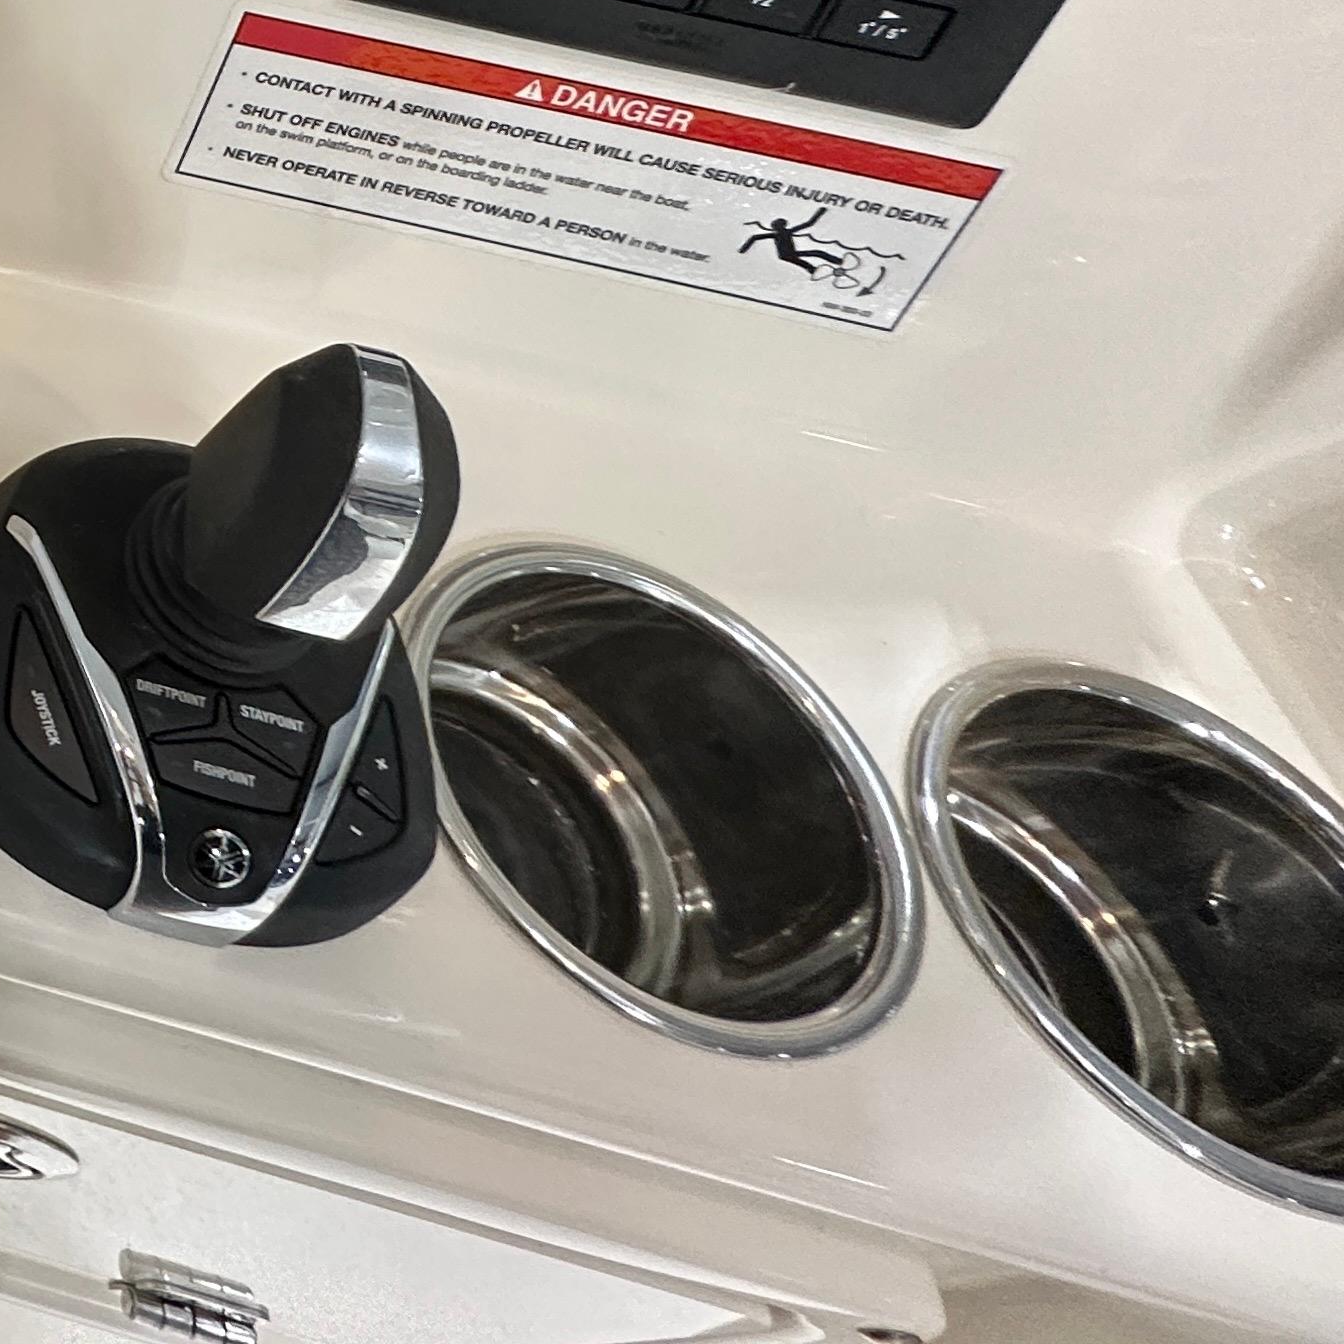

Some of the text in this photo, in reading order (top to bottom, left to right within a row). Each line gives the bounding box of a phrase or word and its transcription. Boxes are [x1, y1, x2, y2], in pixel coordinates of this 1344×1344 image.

[239, 103, 401, 148] SHUT OFF ENGINES
[550, 84, 695, 133] DANGER
[255, 71, 948, 230] CONTACT WITH A SPINNING PROPELLER WILL CAUSE SERIOUS INJURY OR DEATH.
[136, 678, 207, 709] DRIFTPOINT
[30, 688, 63, 747] JOYSTICK
[240, 704, 305, 733] STAYPOINT
[192, 760, 256, 788] FISHPOINT
